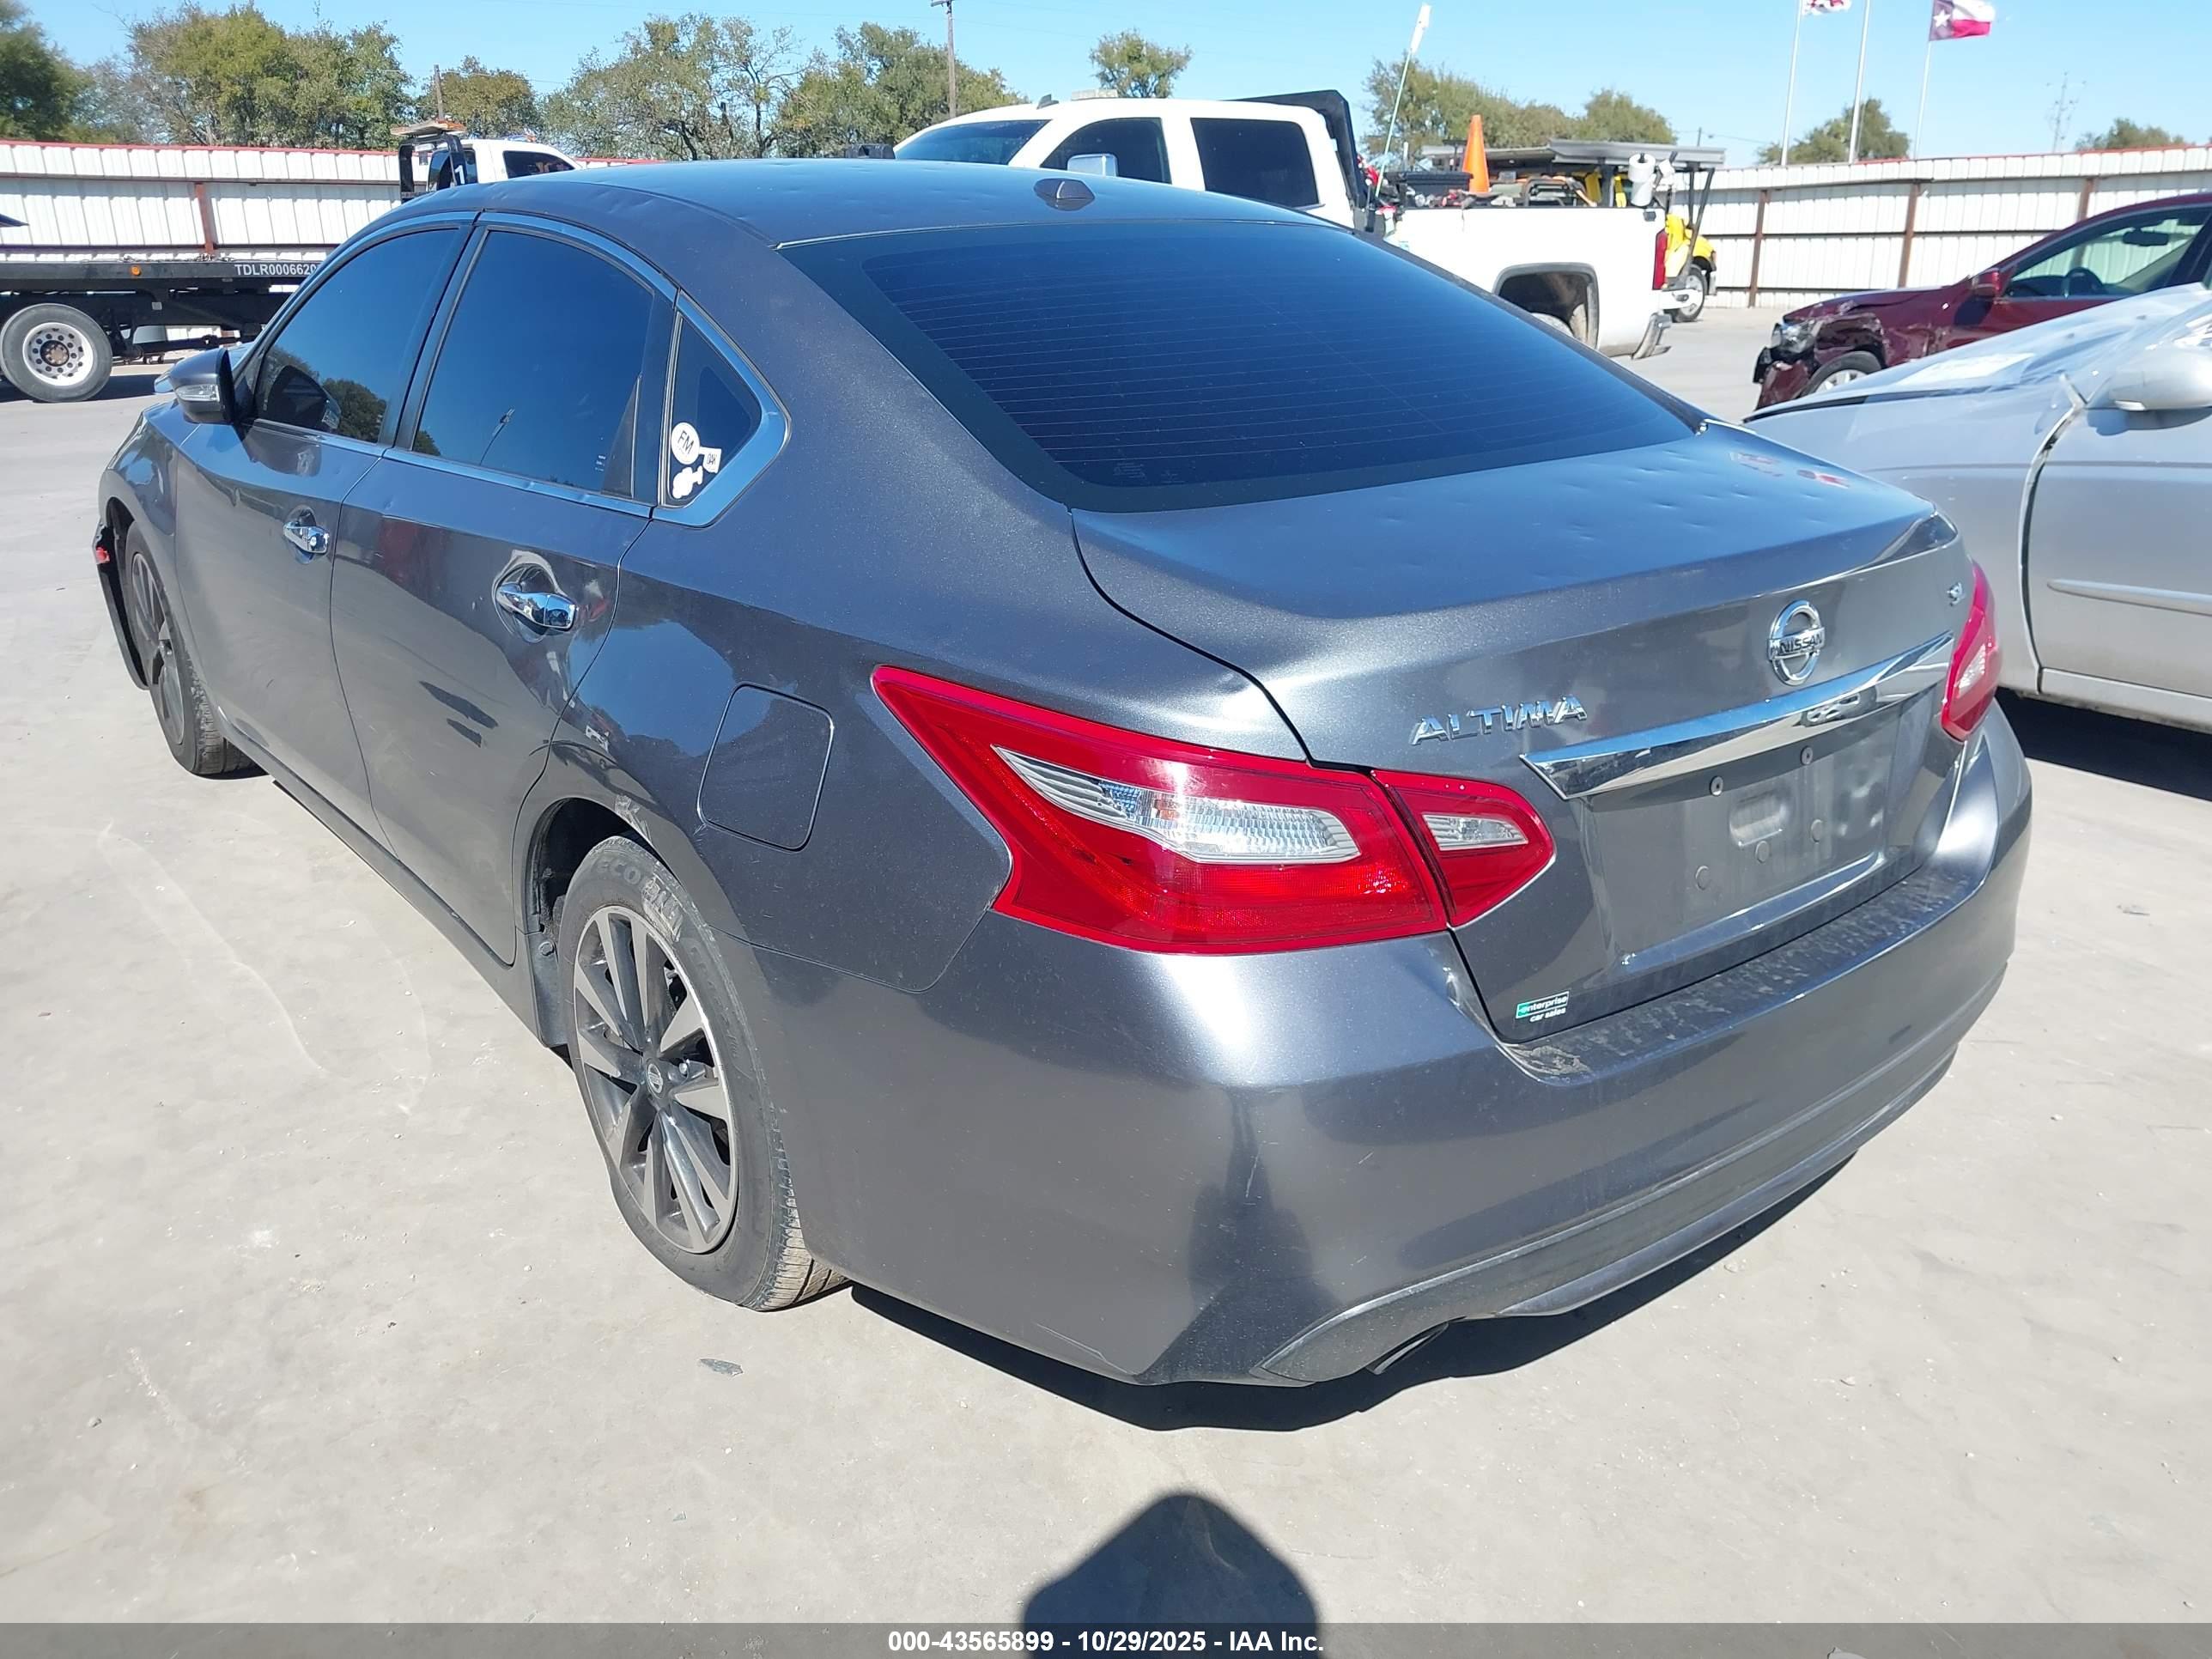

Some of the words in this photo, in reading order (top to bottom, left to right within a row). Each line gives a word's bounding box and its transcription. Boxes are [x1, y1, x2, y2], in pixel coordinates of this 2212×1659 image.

[234, 264, 321, 275] TDLR0006620
[1779, 633, 1822, 653] NISSAN
[1410, 695, 1587, 745] ALTIMA
[1518, 996, 1567, 1013] enterprise
[1529, 1013, 1544, 1022] car
[1545, 1007, 1566, 1018] sales
